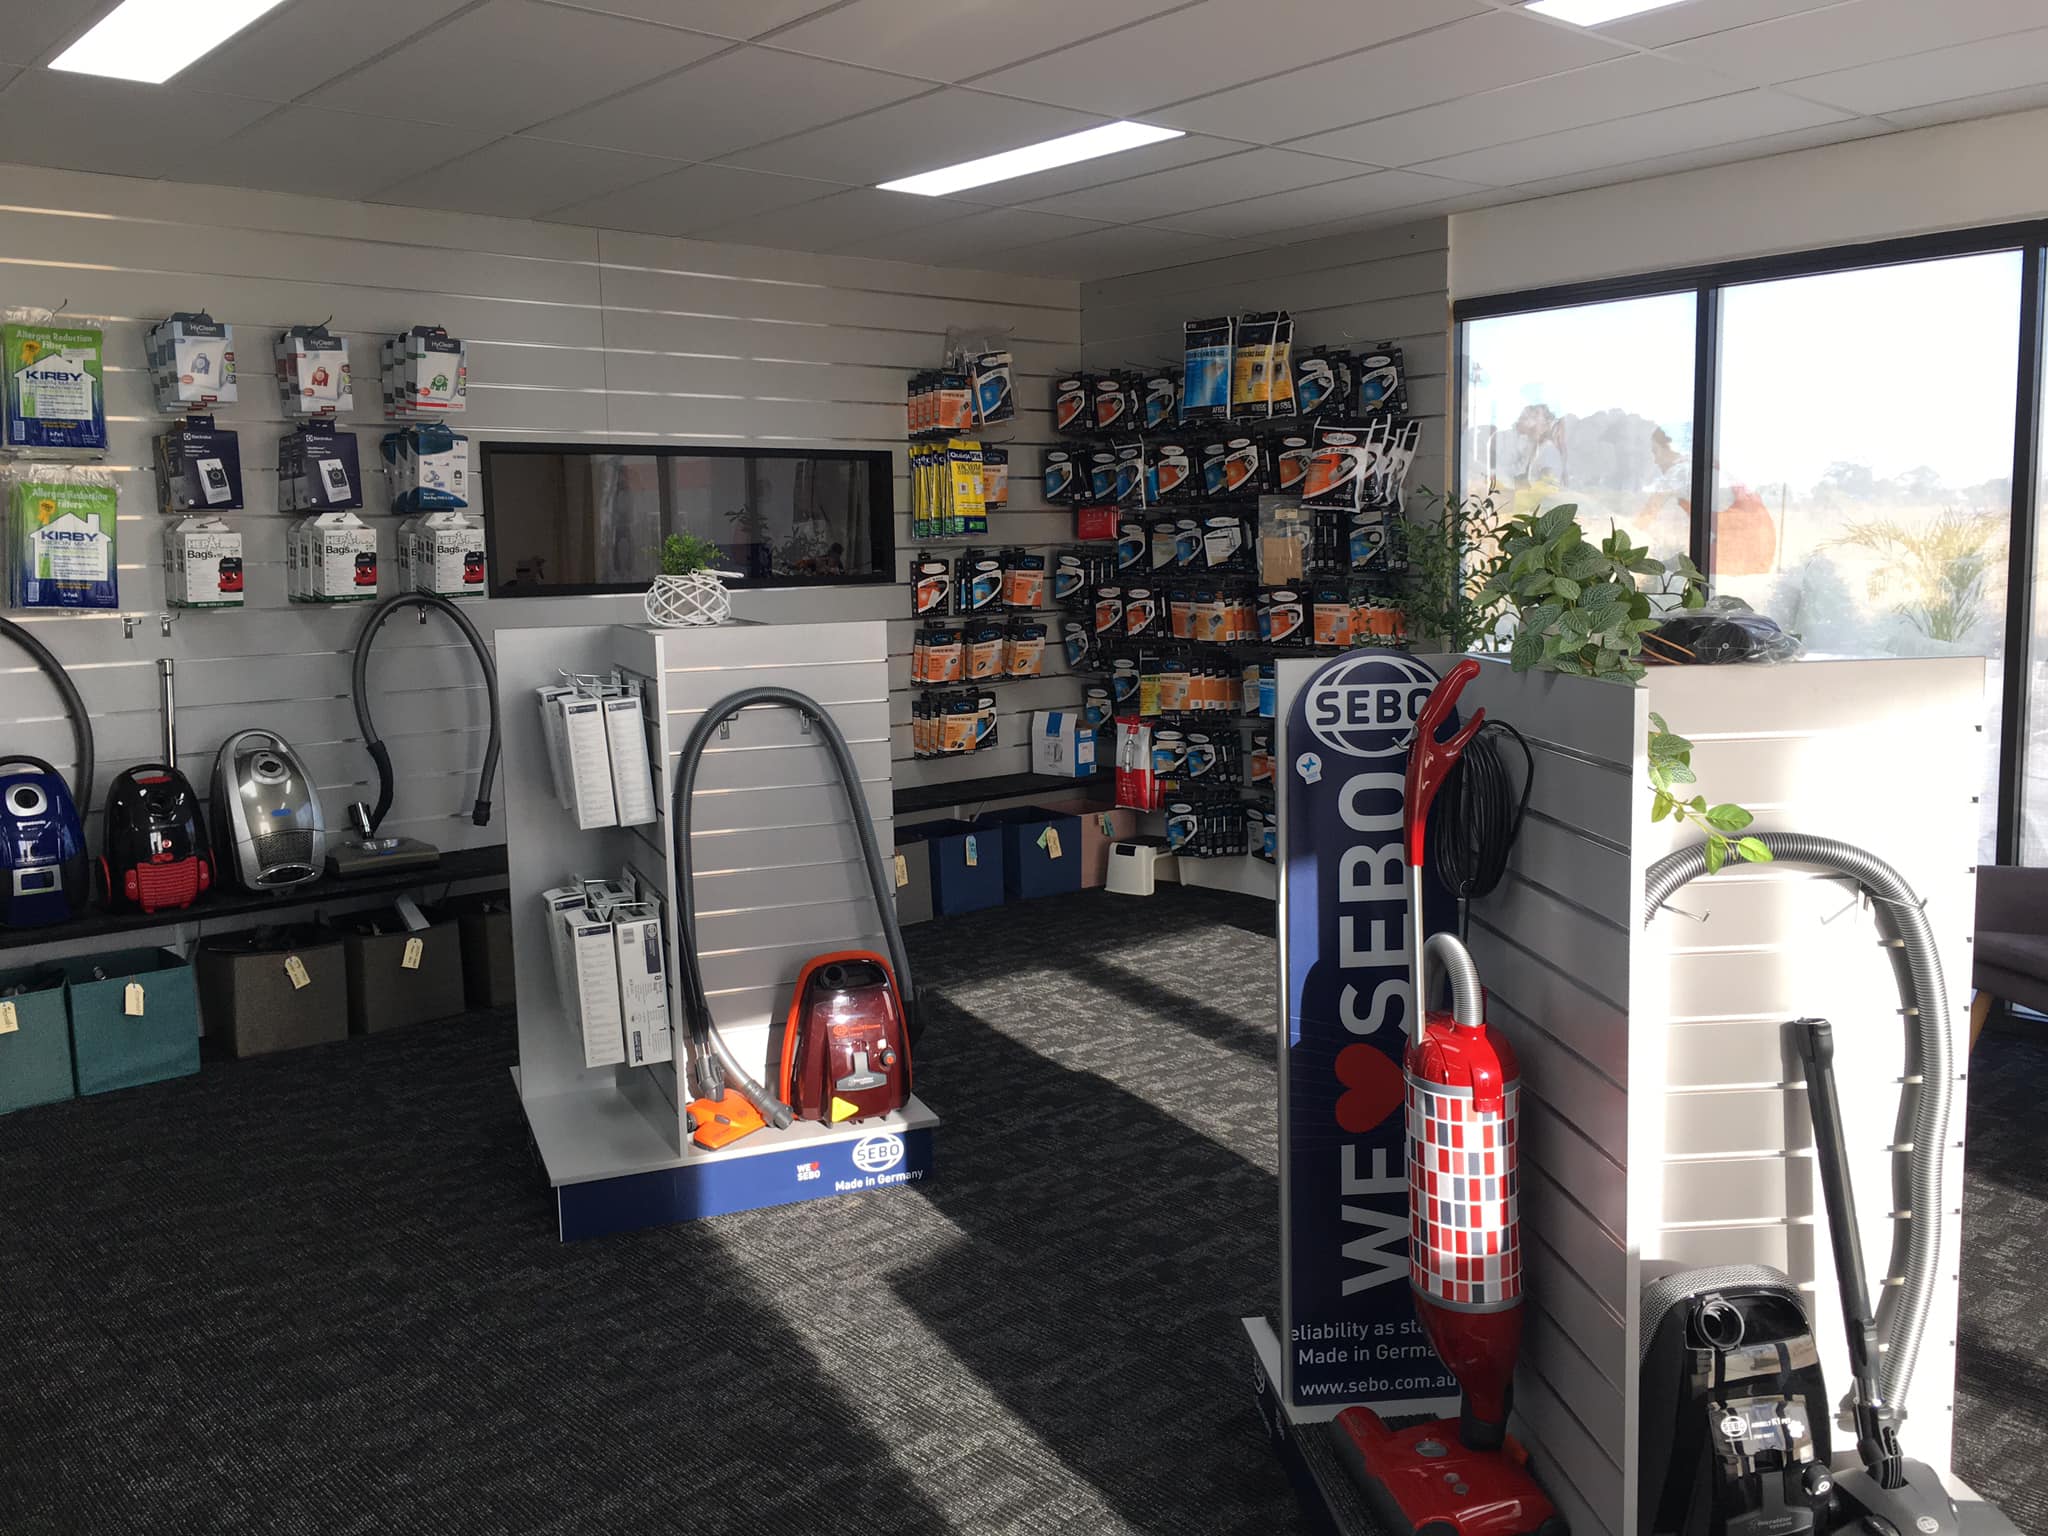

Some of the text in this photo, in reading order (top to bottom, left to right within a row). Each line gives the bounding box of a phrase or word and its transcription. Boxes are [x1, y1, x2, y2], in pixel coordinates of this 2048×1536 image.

[16, 330, 93, 342] Allergen Reduction
[26, 371, 83, 381] KIRBY
[32, 487, 65, 500] Allergen
[57, 501, 83, 509] Filters
[41, 531, 99, 542] KIRBY
[187, 550, 213, 560] Bags
[326, 545, 350, 555] Bags
[437, 545, 459, 555] Bags
[1316, 688, 1431, 726] SEBO
[1338, 772, 1413, 1035] SEBO
[857, 1144, 900, 1161] SEBO
[796, 1162, 811, 1172] WE
[797, 1169, 821, 1182] SEBO
[835, 1169, 924, 1191] Made in Germany
[1341, 1144, 1410, 1296] WE
[1291, 1322, 1369, 1341] eliability
[1374, 1322, 1395, 1336] as
[1299, 1345, 1437, 1365] Made in Germa
[1300, 1375, 1457, 1397] www.sebo.com.au
[1722, 1422, 1746, 1432] SEBO
